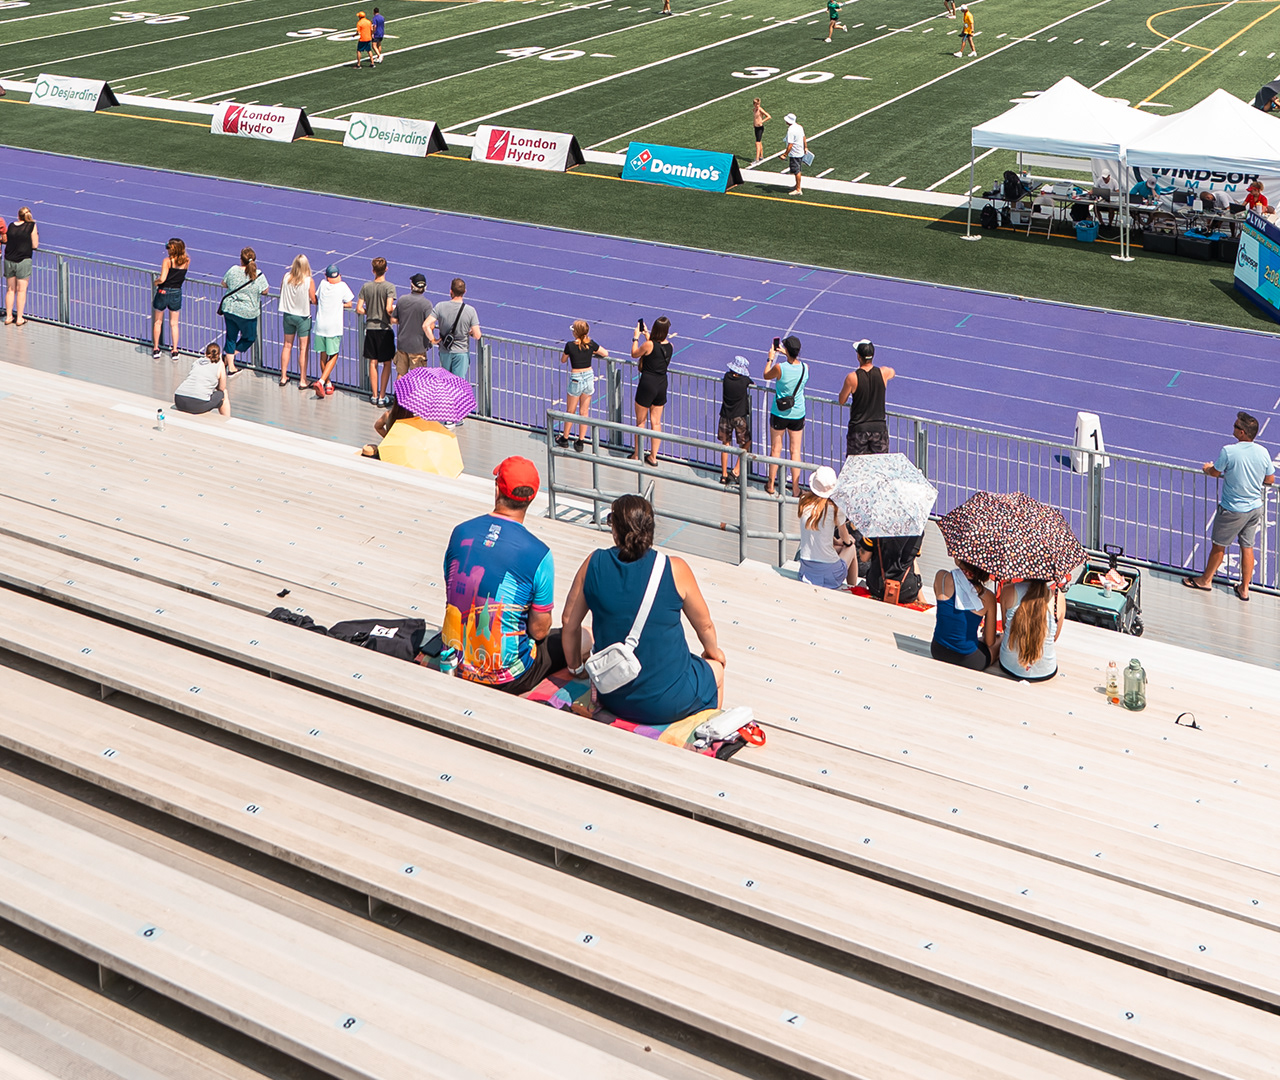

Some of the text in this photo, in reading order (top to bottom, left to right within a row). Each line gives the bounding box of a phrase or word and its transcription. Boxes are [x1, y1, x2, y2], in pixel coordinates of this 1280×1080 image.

[731, 65, 834, 85] 30
[50, 85, 98, 102] Desjardins
[242, 110, 285, 123] London
[240, 122, 273, 135] Hydro
[369, 126, 427, 146] Desjardins
[510, 135, 557, 151] London
[507, 147, 545, 163] Hydro
[650, 158, 721, 182] Domino's
[1151, 167, 1260, 186] WINDSOR
[1250, 213, 1267, 232] LYNX
[1090, 429, 1099, 450] 1
